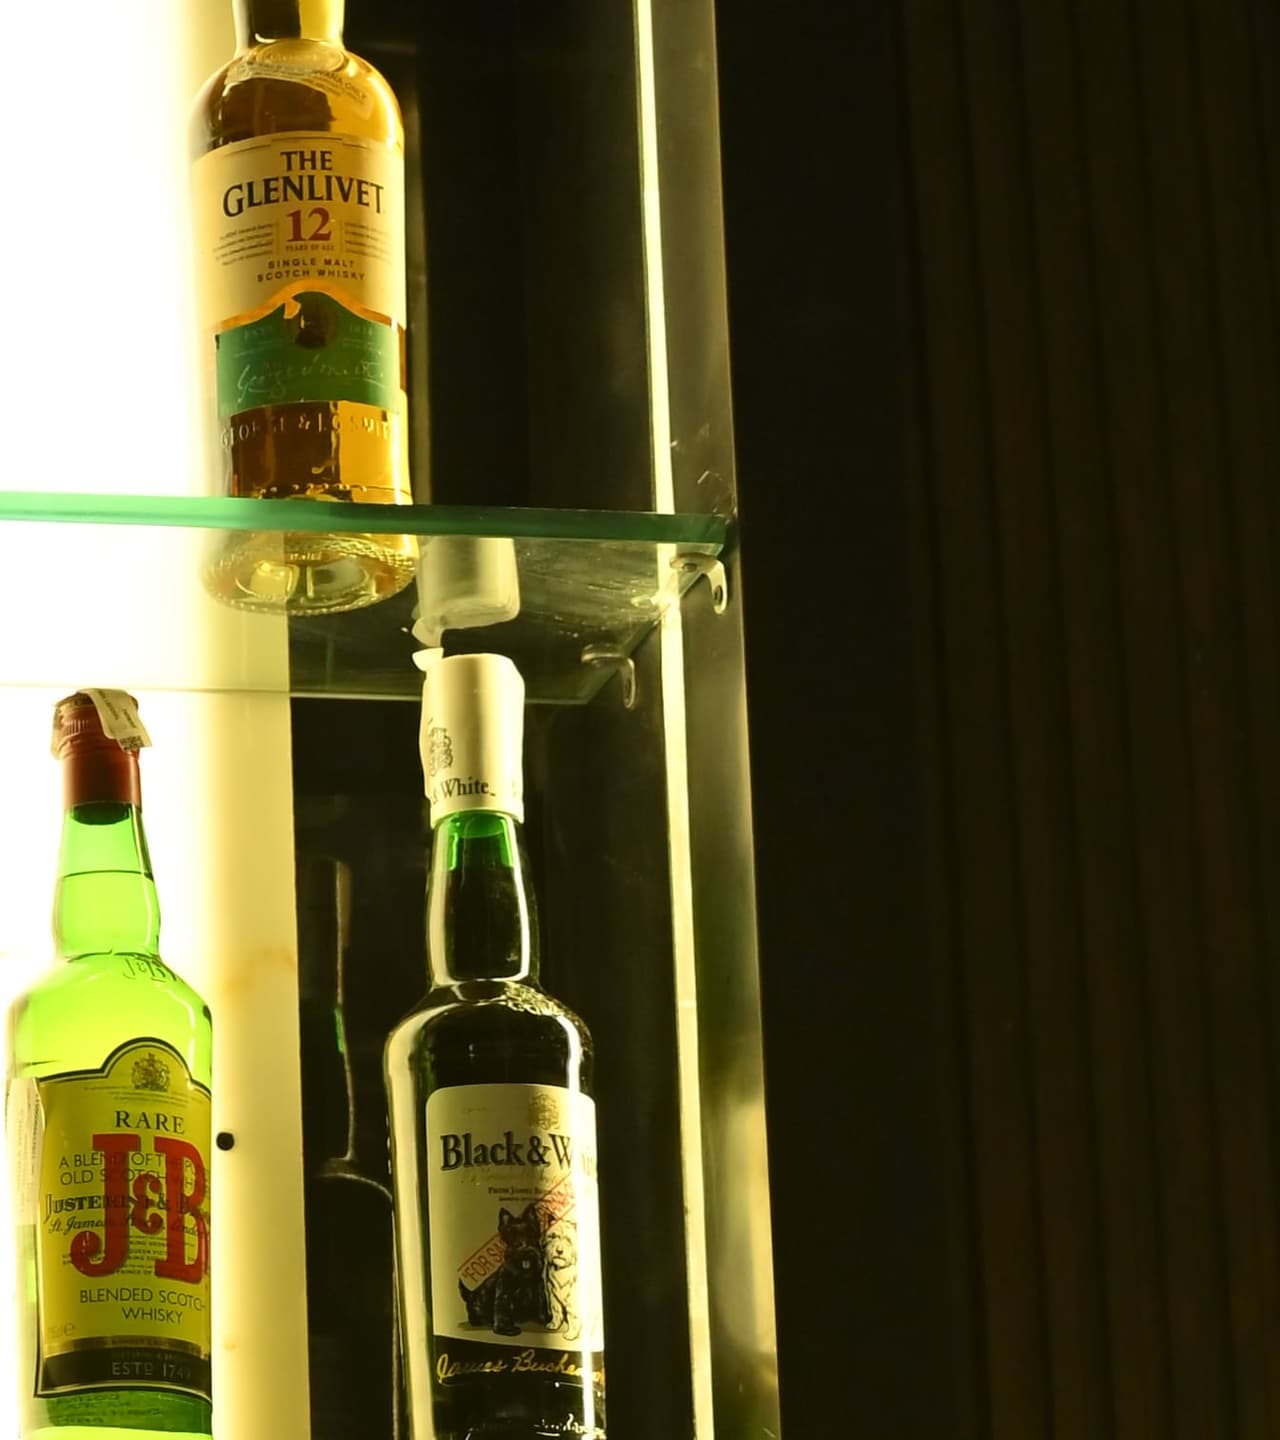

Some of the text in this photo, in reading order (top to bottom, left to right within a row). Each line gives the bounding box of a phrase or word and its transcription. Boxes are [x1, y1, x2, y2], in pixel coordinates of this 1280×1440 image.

[279, 149, 333, 172] THE
[222, 174, 385, 219] GLENLIVET
[285, 206, 333, 243] 12
[267, 257, 355, 269] SINGLE MALT
[256, 268, 365, 282] SCOTCH WHISKY
[440, 775, 488, 799] White
[114, 1109, 185, 1135] RARE
[59, 1168, 94, 1186] OLD
[69, 1133, 209, 1286] J&B
[79, 1286, 153, 1305] BLENDED
[121, 1306, 184, 1326] WHISKY
